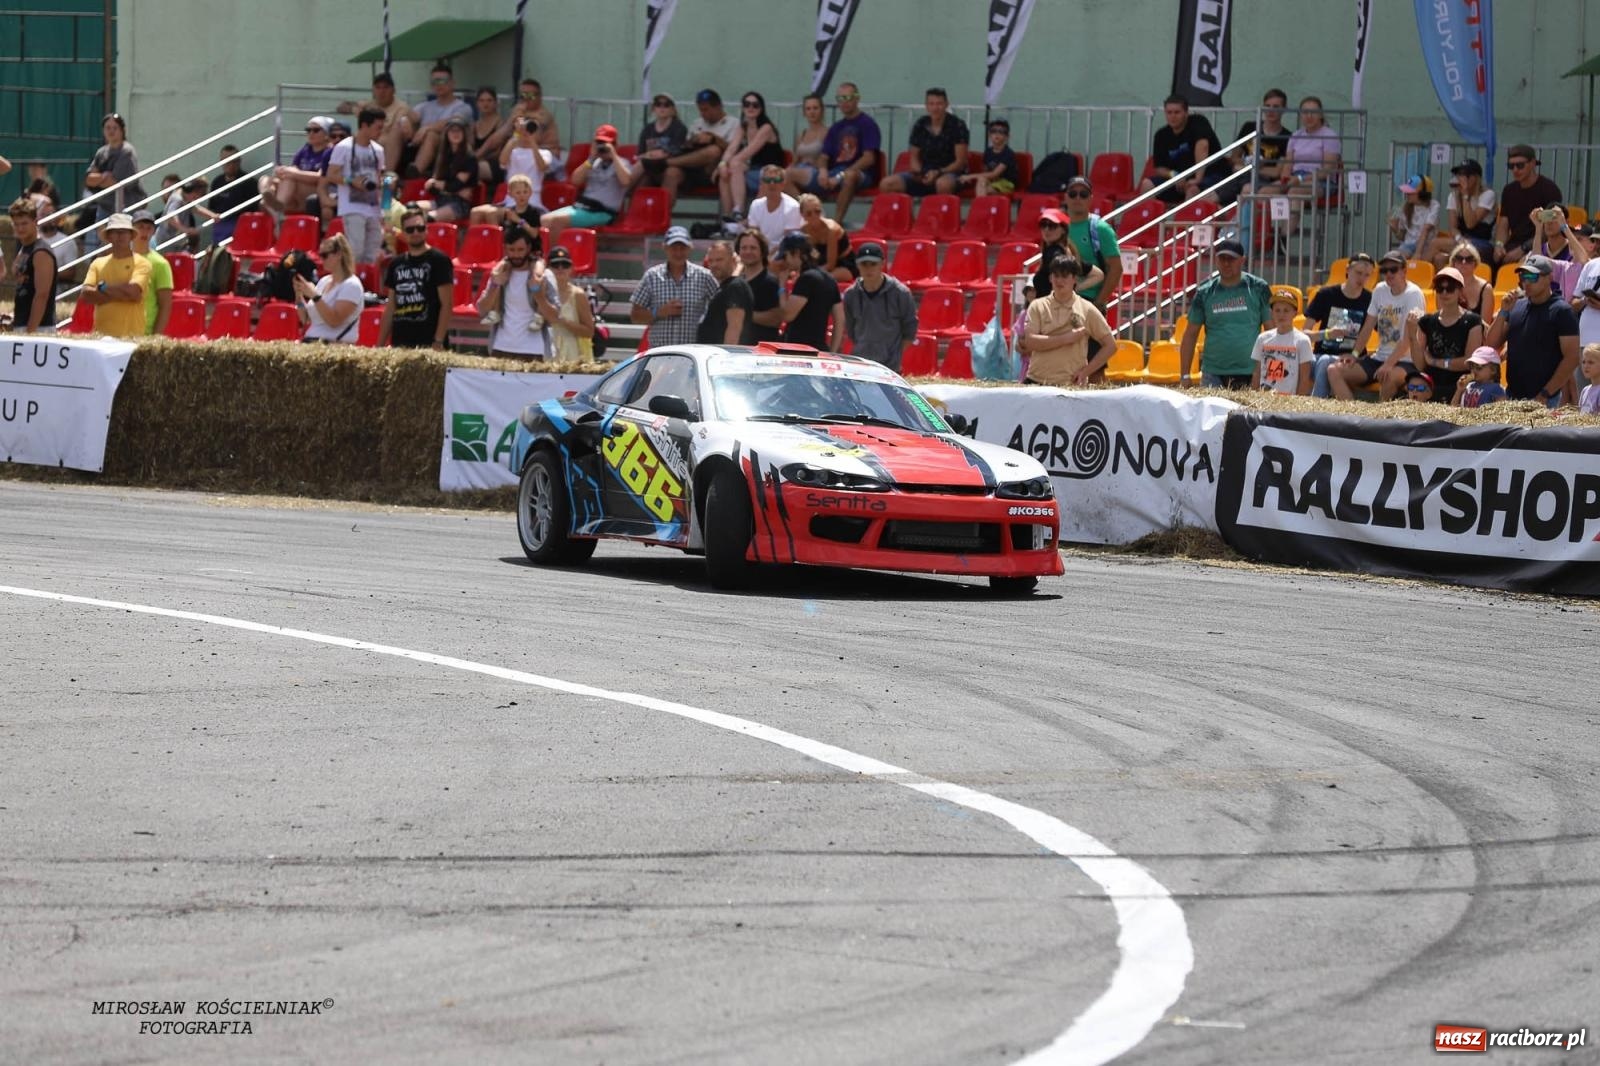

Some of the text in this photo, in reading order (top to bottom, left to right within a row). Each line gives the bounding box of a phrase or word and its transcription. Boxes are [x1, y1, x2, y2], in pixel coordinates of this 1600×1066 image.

[12, 342, 70, 369] FUS
[602, 418, 683, 524] 366
[1006, 419, 1214, 483] AGRONOVA
[805, 493, 887, 512] Sentta
[1008, 506, 1054, 517] #KO366
[1252, 445, 1600, 544] RALLYSHOP
